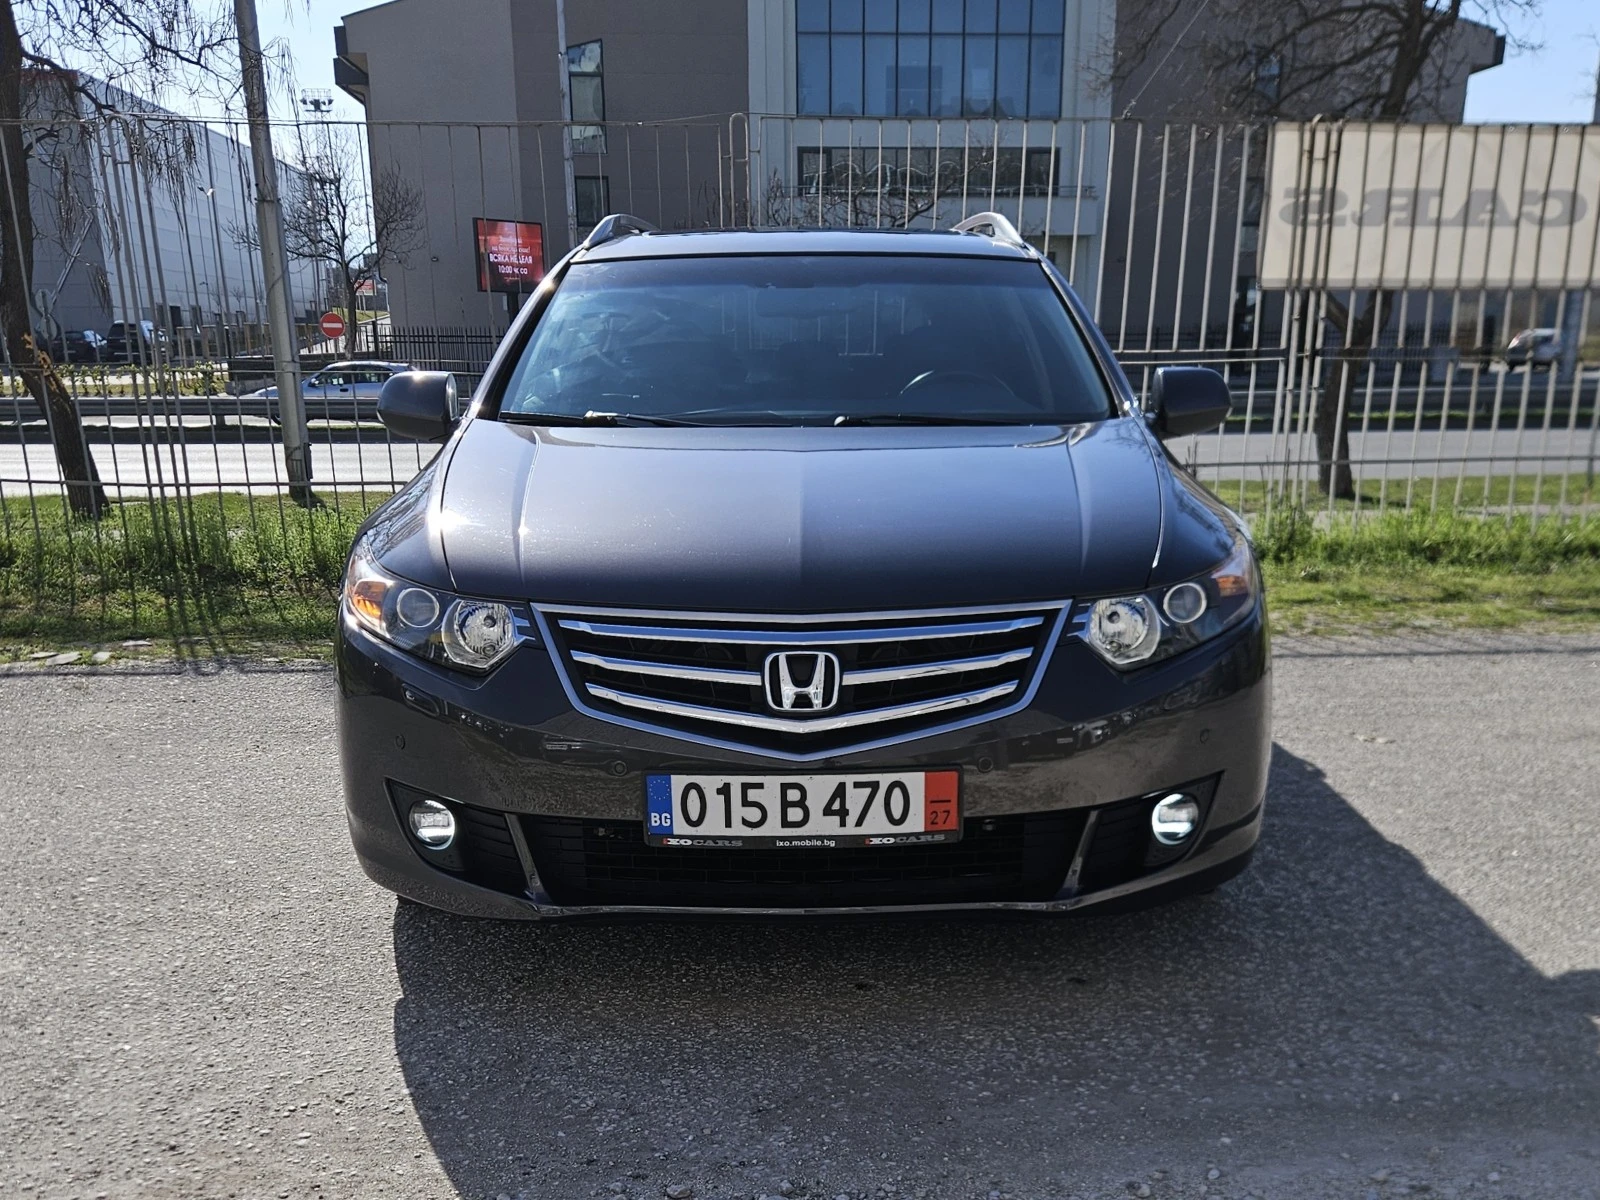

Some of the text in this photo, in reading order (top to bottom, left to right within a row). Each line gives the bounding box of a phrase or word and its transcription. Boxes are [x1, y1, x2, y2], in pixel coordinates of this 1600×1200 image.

[489, 253, 509, 262] ВСЯКА
[498, 265, 513, 274] 10:00
[650, 813, 671, 827] BG
[930, 810, 951, 826] 27
